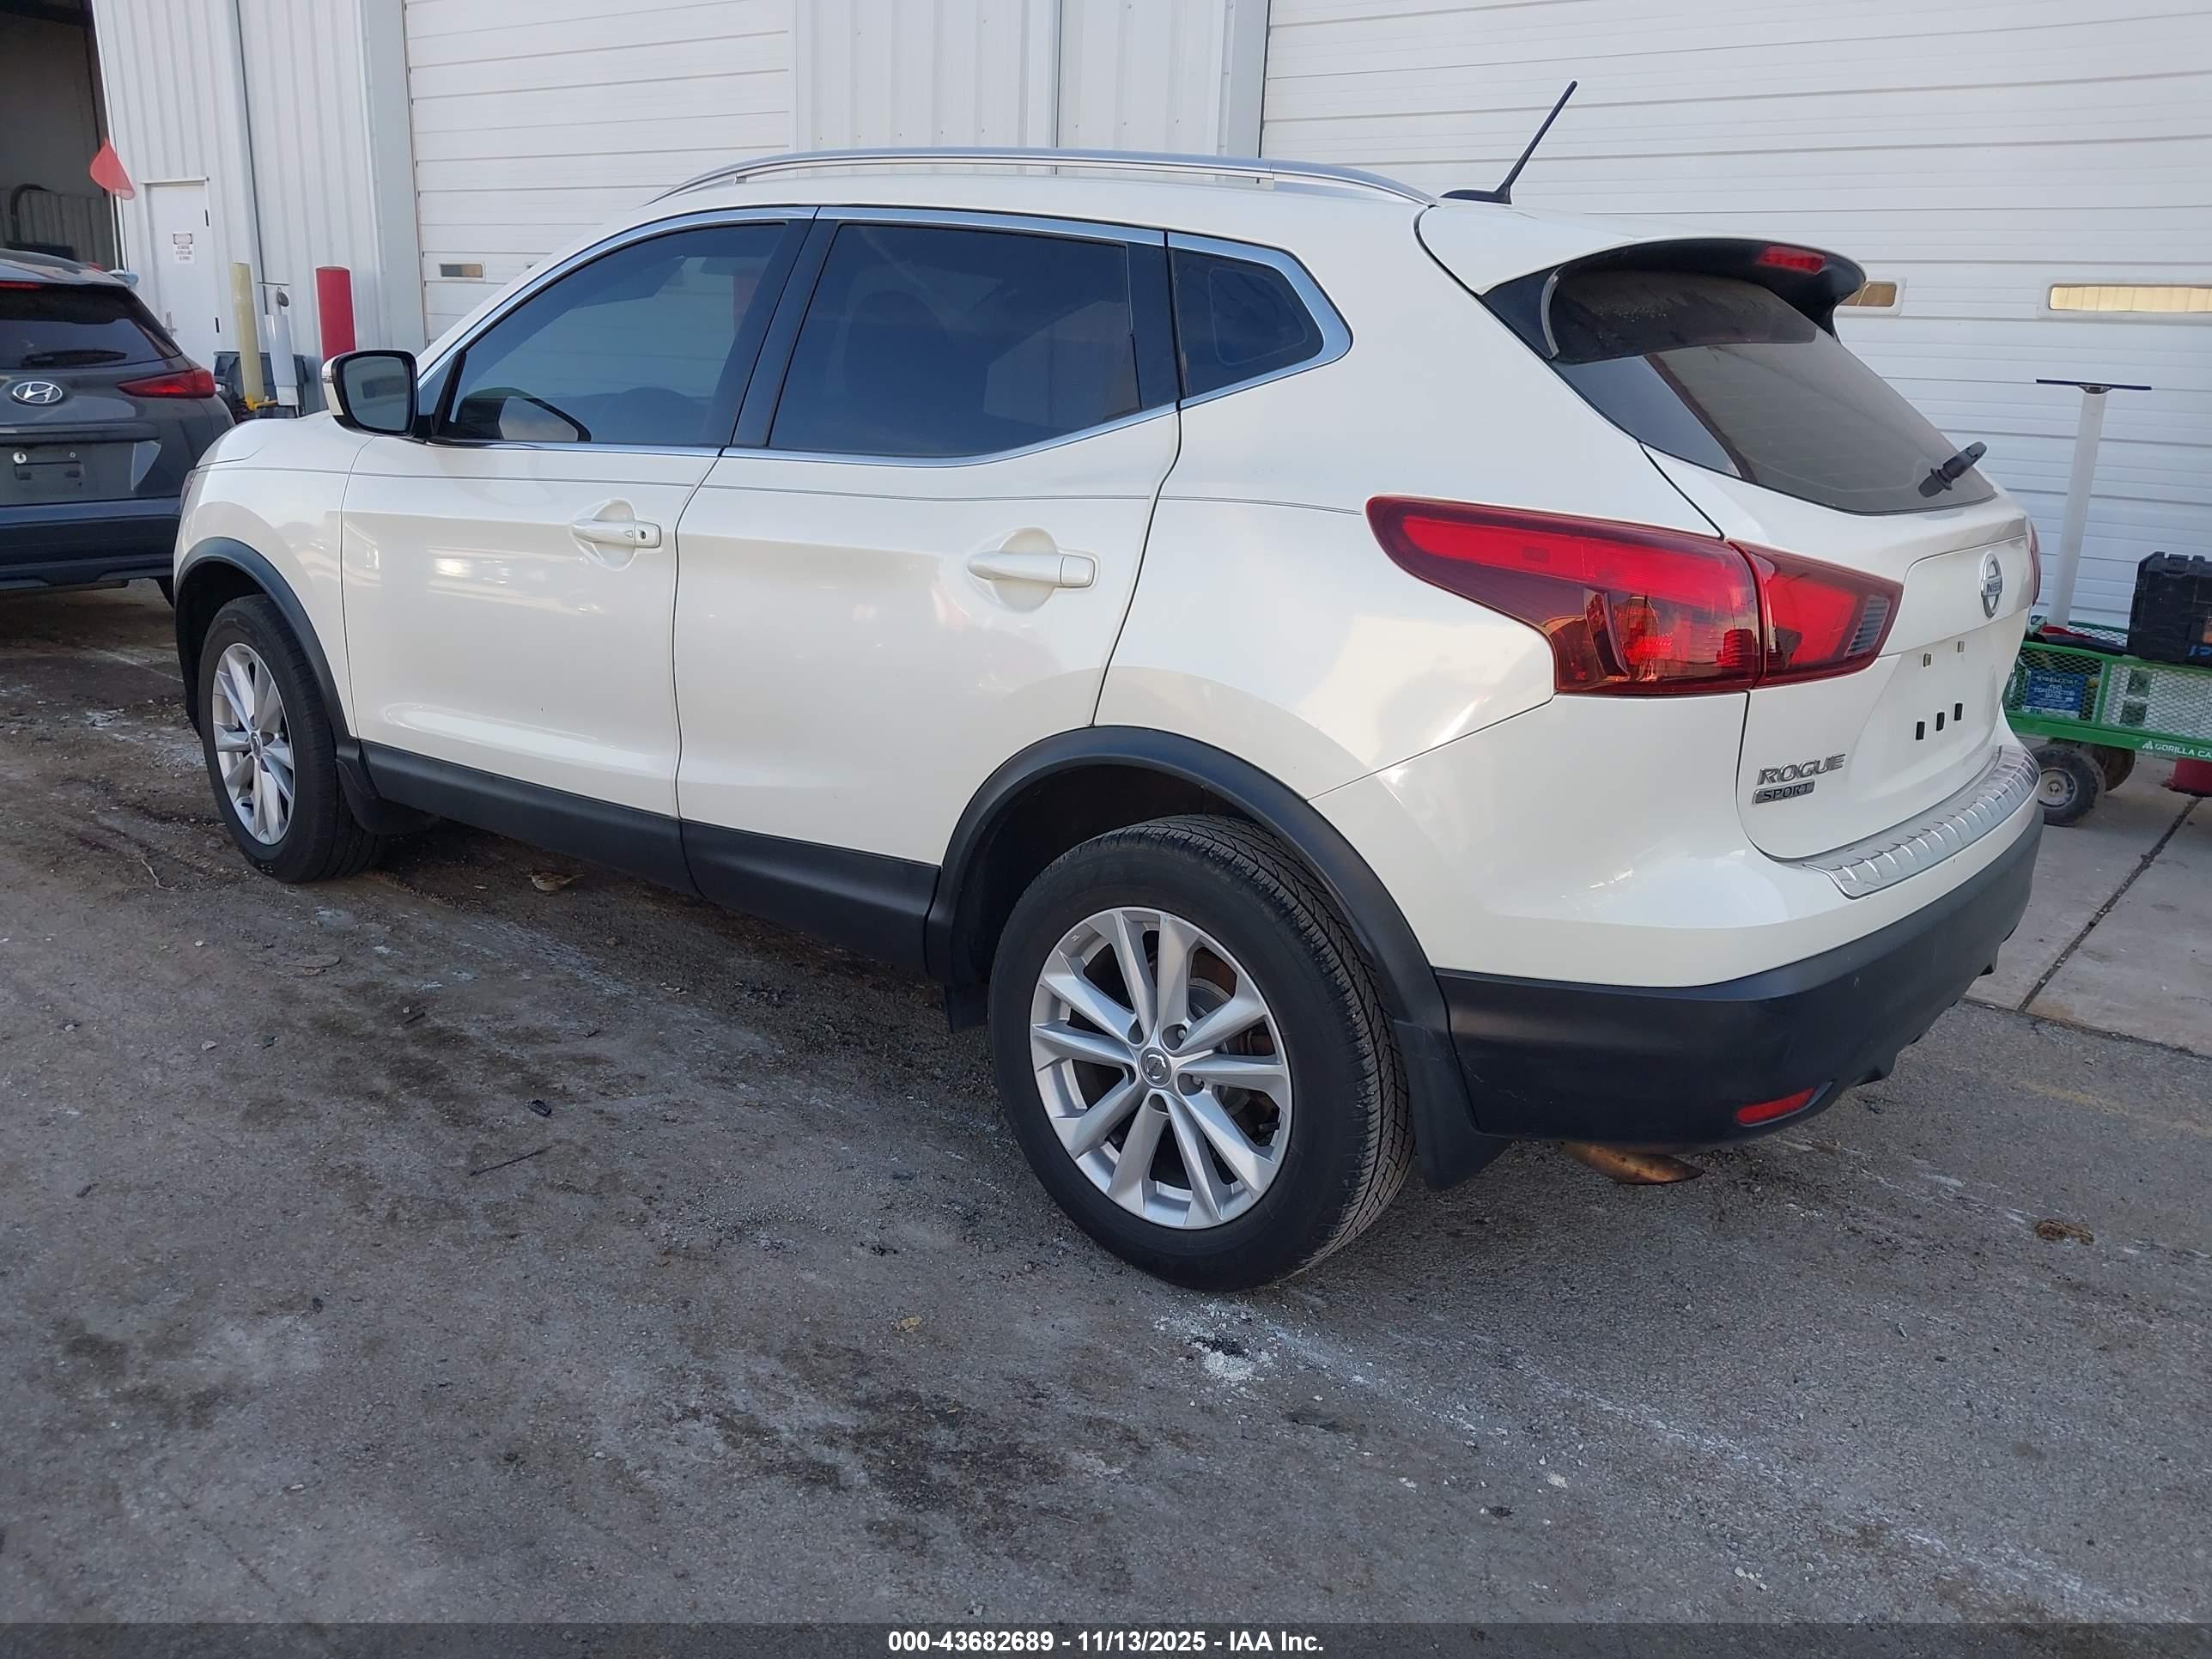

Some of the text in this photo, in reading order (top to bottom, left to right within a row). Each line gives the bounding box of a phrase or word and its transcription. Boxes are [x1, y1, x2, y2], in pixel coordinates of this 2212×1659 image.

[2154, 742, 2195, 756] GORILLA
[1757, 753, 1846, 786] ROGUE
[1761, 782, 1810, 801] SPORT
